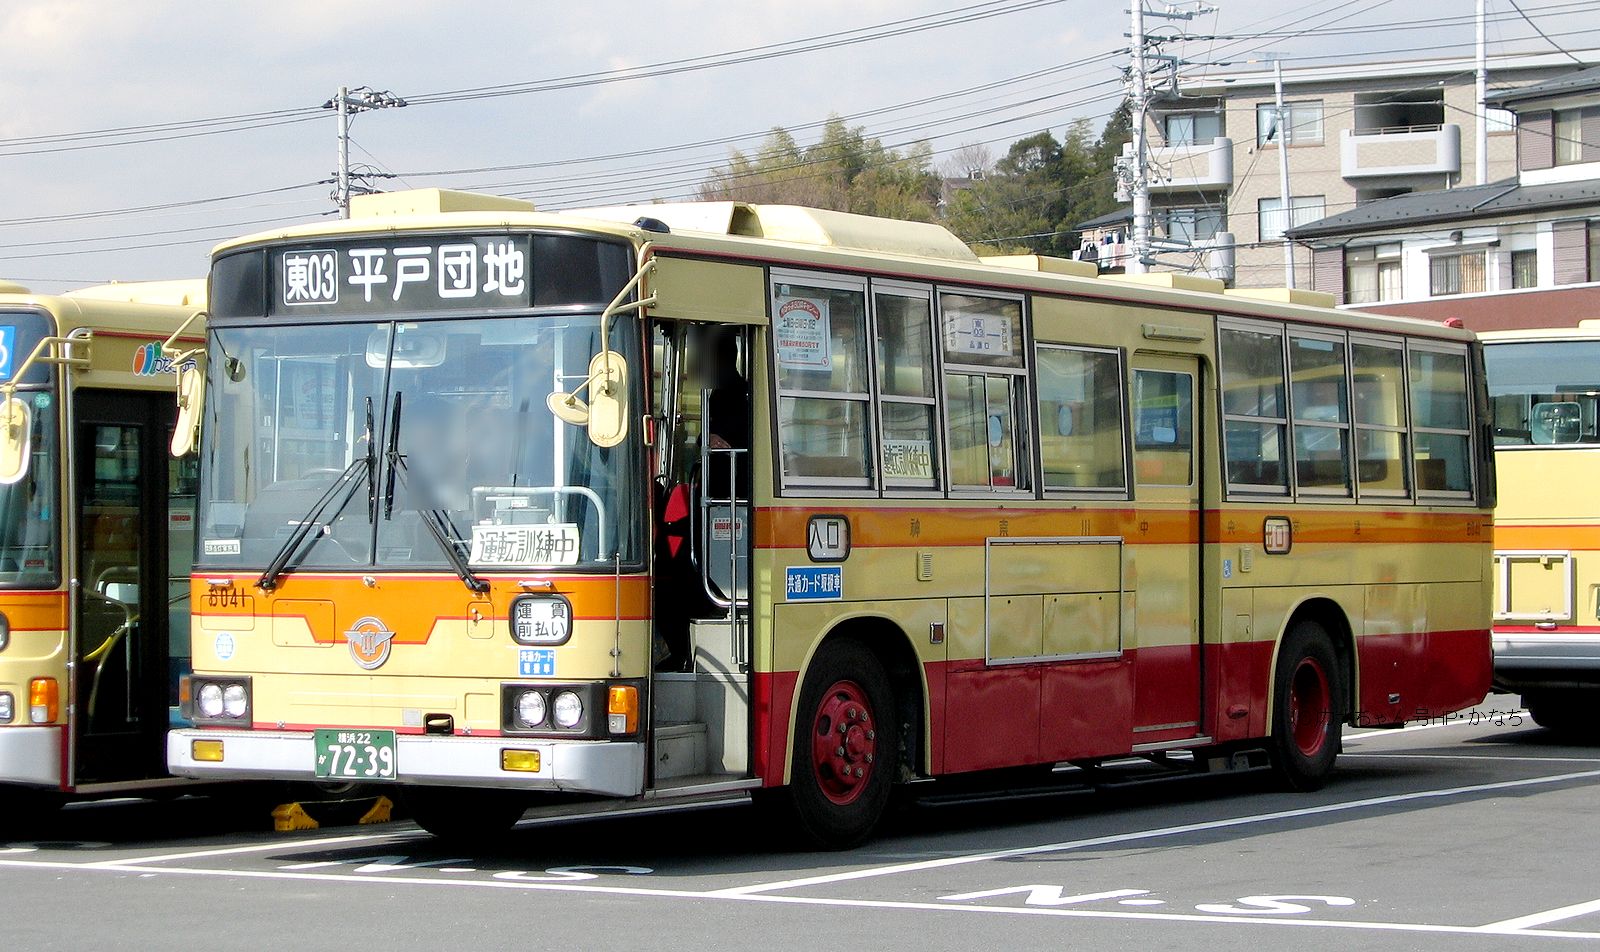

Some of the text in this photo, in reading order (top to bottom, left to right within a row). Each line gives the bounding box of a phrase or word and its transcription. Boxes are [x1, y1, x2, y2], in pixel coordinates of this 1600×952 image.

[287, 241, 525, 302] 東03 平戸団地
[475, 528, 574, 563] 運転訓練中
[810, 521, 839, 549] 入口
[787, 573, 841, 593] 共通カード取扱車
[518, 602, 565, 619] 運賃
[518, 621, 565, 637] 前払い
